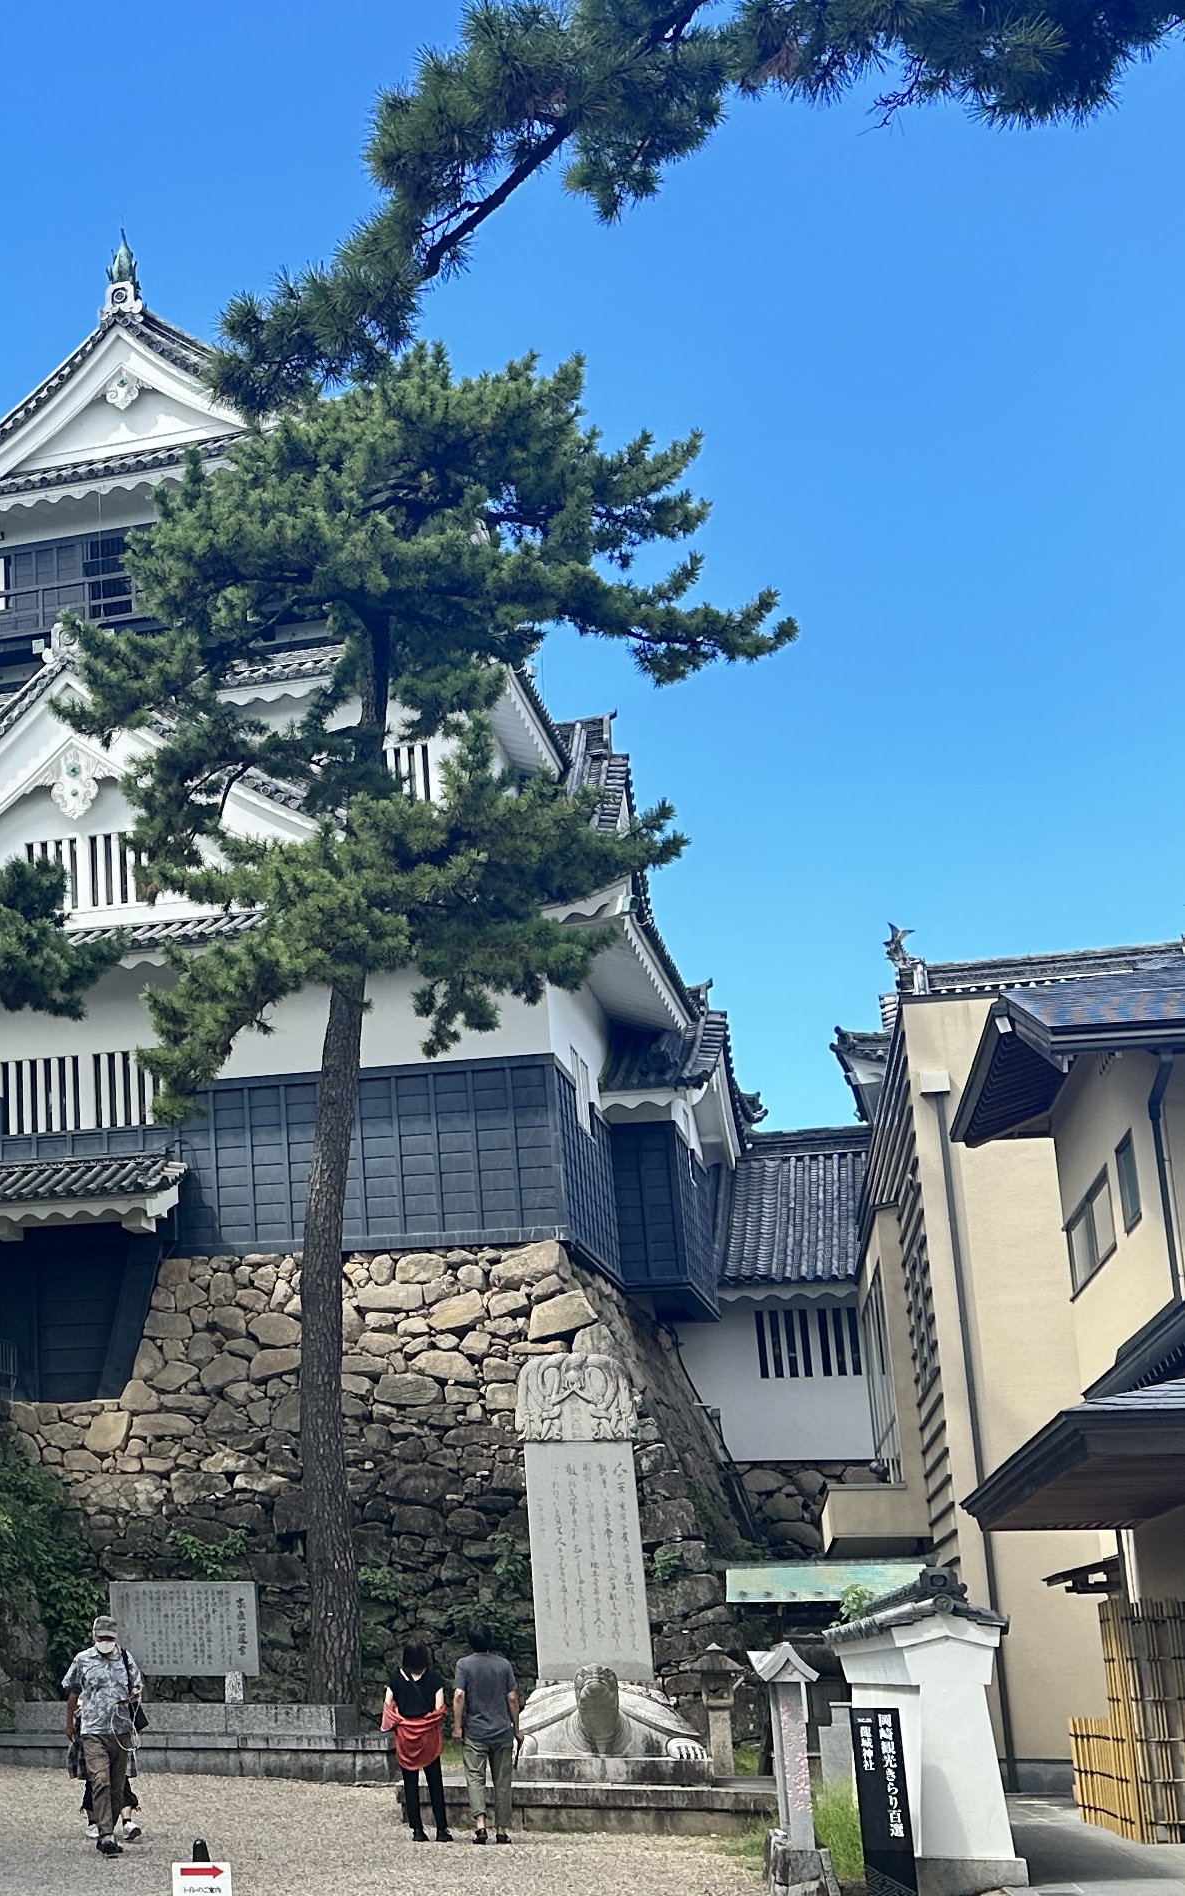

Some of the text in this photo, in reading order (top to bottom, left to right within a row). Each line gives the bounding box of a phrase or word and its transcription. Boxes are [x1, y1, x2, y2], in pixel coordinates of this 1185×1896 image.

[859, 1726, 875, 1771] 龍城神社
[878, 1714, 905, 1837] 岡崎観光きらり百選
